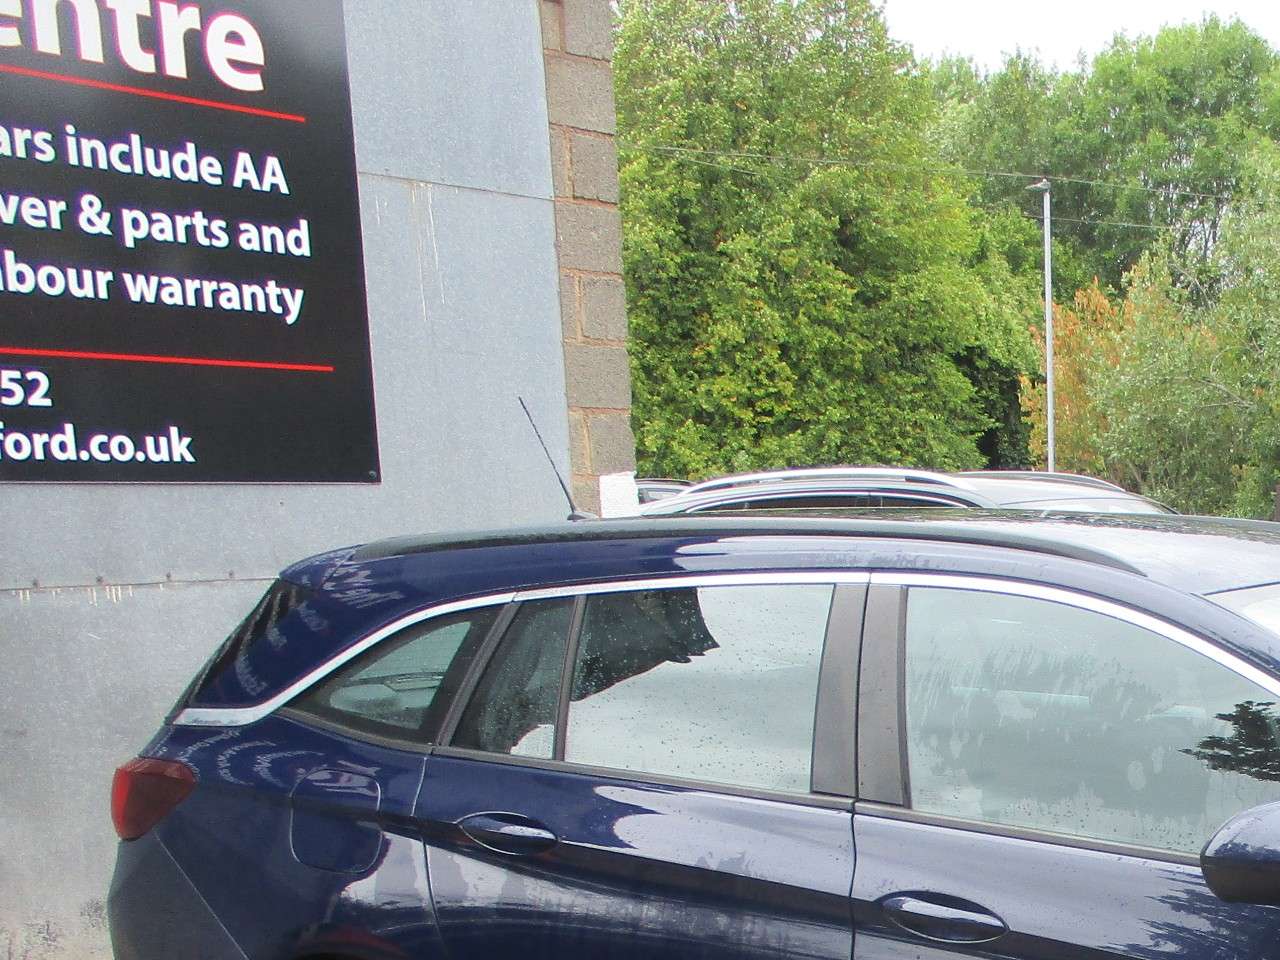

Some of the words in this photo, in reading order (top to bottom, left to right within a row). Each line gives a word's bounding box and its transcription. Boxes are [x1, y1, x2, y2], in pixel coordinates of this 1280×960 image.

[65, 124, 223, 186] include
[232, 152, 290, 194] AA
[78, 193, 111, 235] &
[121, 205, 230, 250] parts
[238, 219, 312, 257] and
[0, 249, 114, 301] bour
[123, 272, 304, 325] warranty
[0, 421, 196, 463] ord.co.uk
